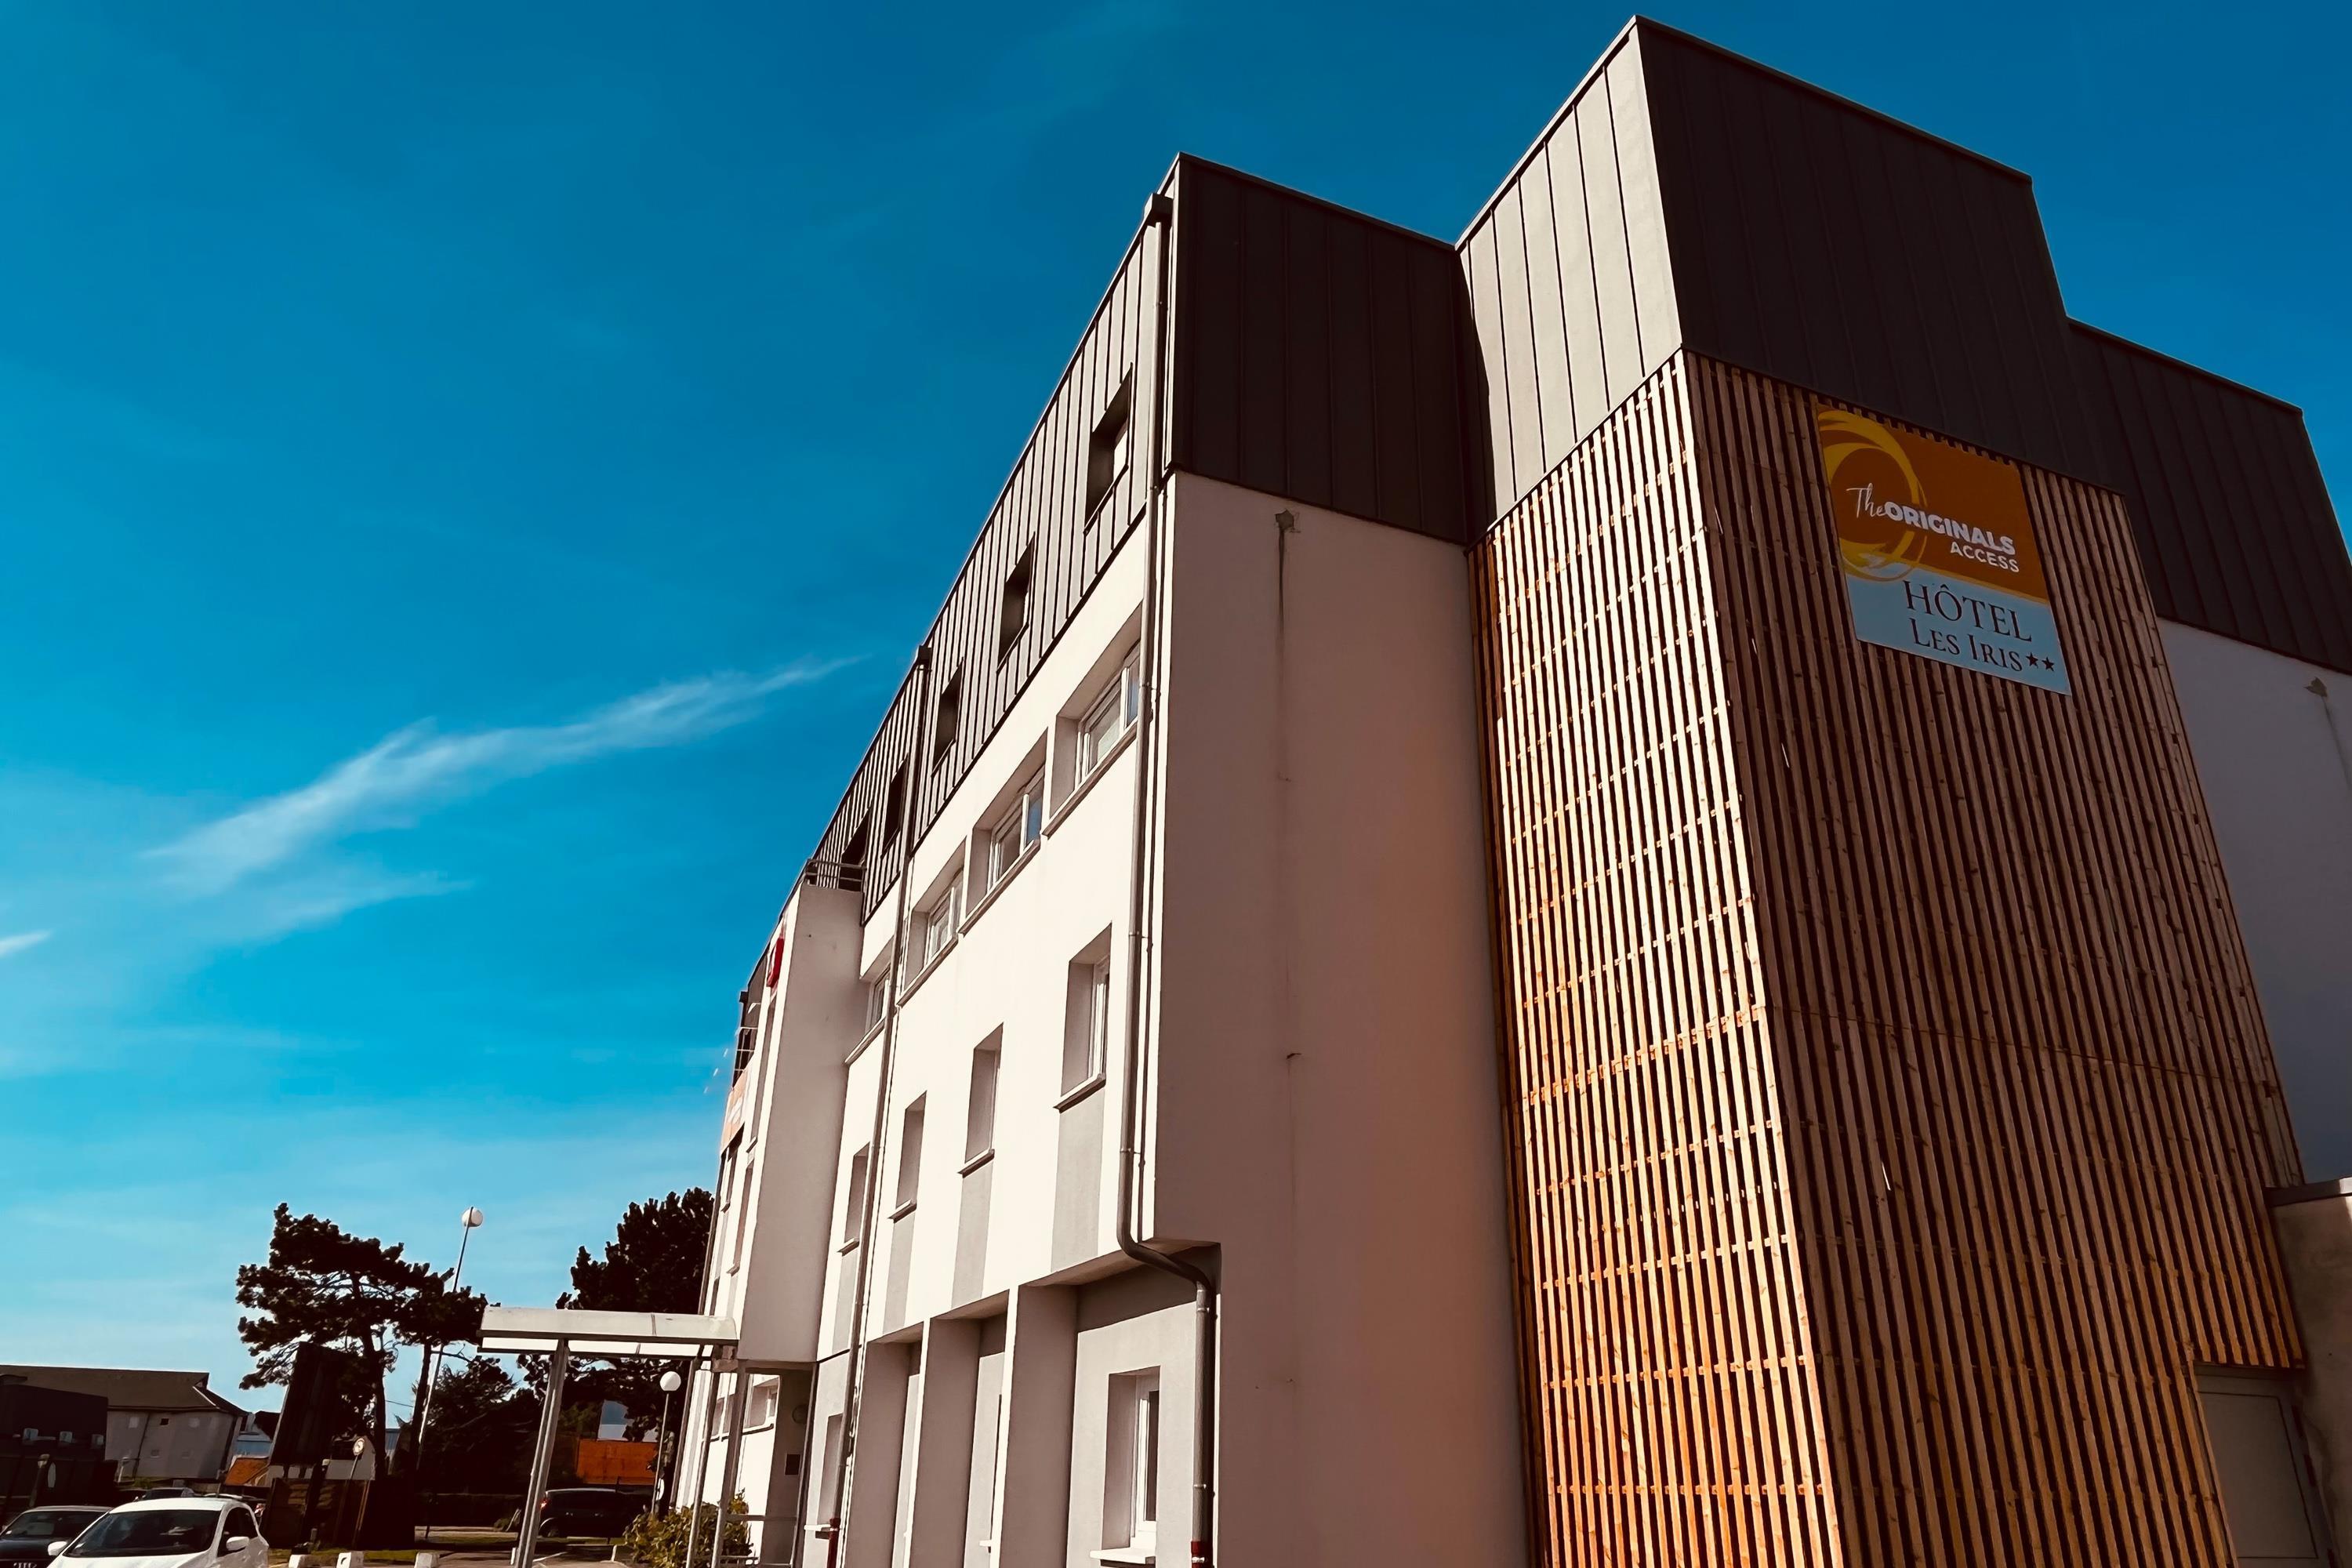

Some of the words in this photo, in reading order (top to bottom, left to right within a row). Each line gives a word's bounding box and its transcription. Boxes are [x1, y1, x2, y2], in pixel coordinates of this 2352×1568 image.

[1846, 483, 1886, 518] The
[1884, 501, 2016, 556] ORIGINALS
[1950, 542, 2020, 573] ACCESS
[1903, 580, 2032, 642] HÔTEL
